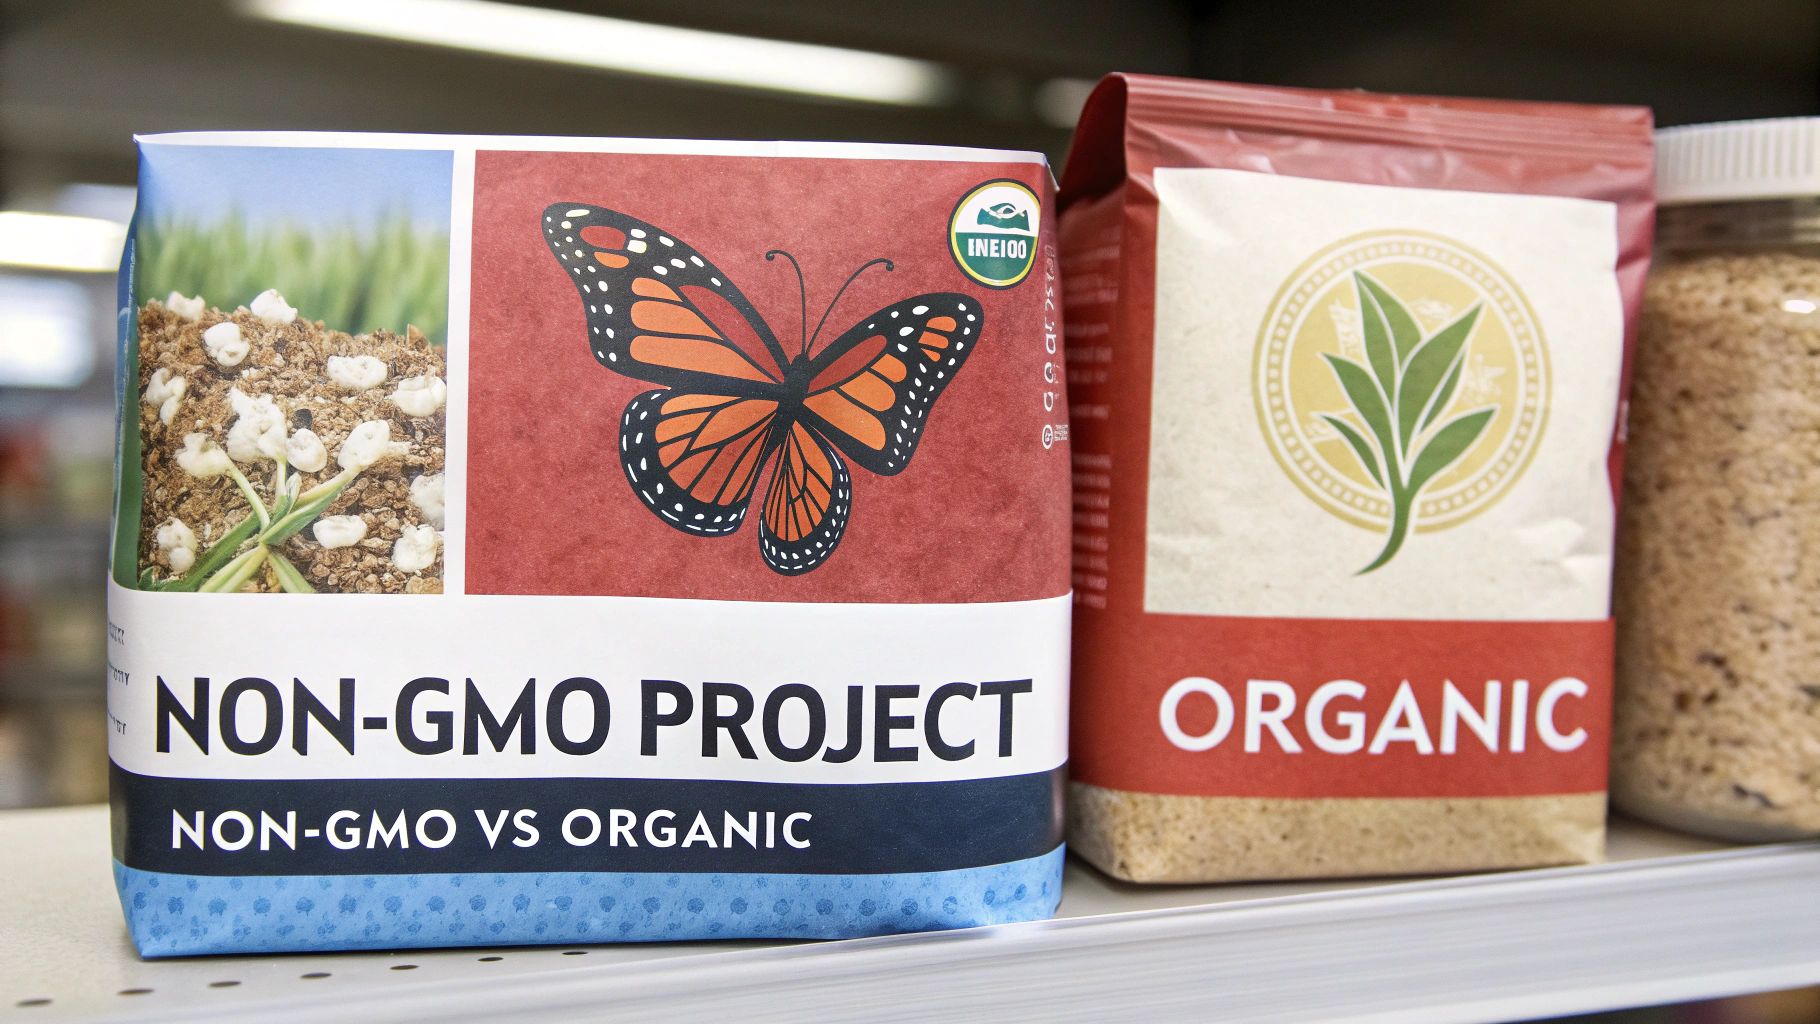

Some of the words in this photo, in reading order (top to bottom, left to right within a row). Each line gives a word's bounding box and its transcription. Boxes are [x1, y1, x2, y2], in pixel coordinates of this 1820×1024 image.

[156, 675, 611, 757] NON-GMO
[640, 678, 1033, 764] PROJECT
[1159, 676, 1588, 755] ORGANIC
[172, 808, 457, 852] NON-GMO
[473, 808, 540, 850] VS
[561, 808, 813, 850] ORGANIC
